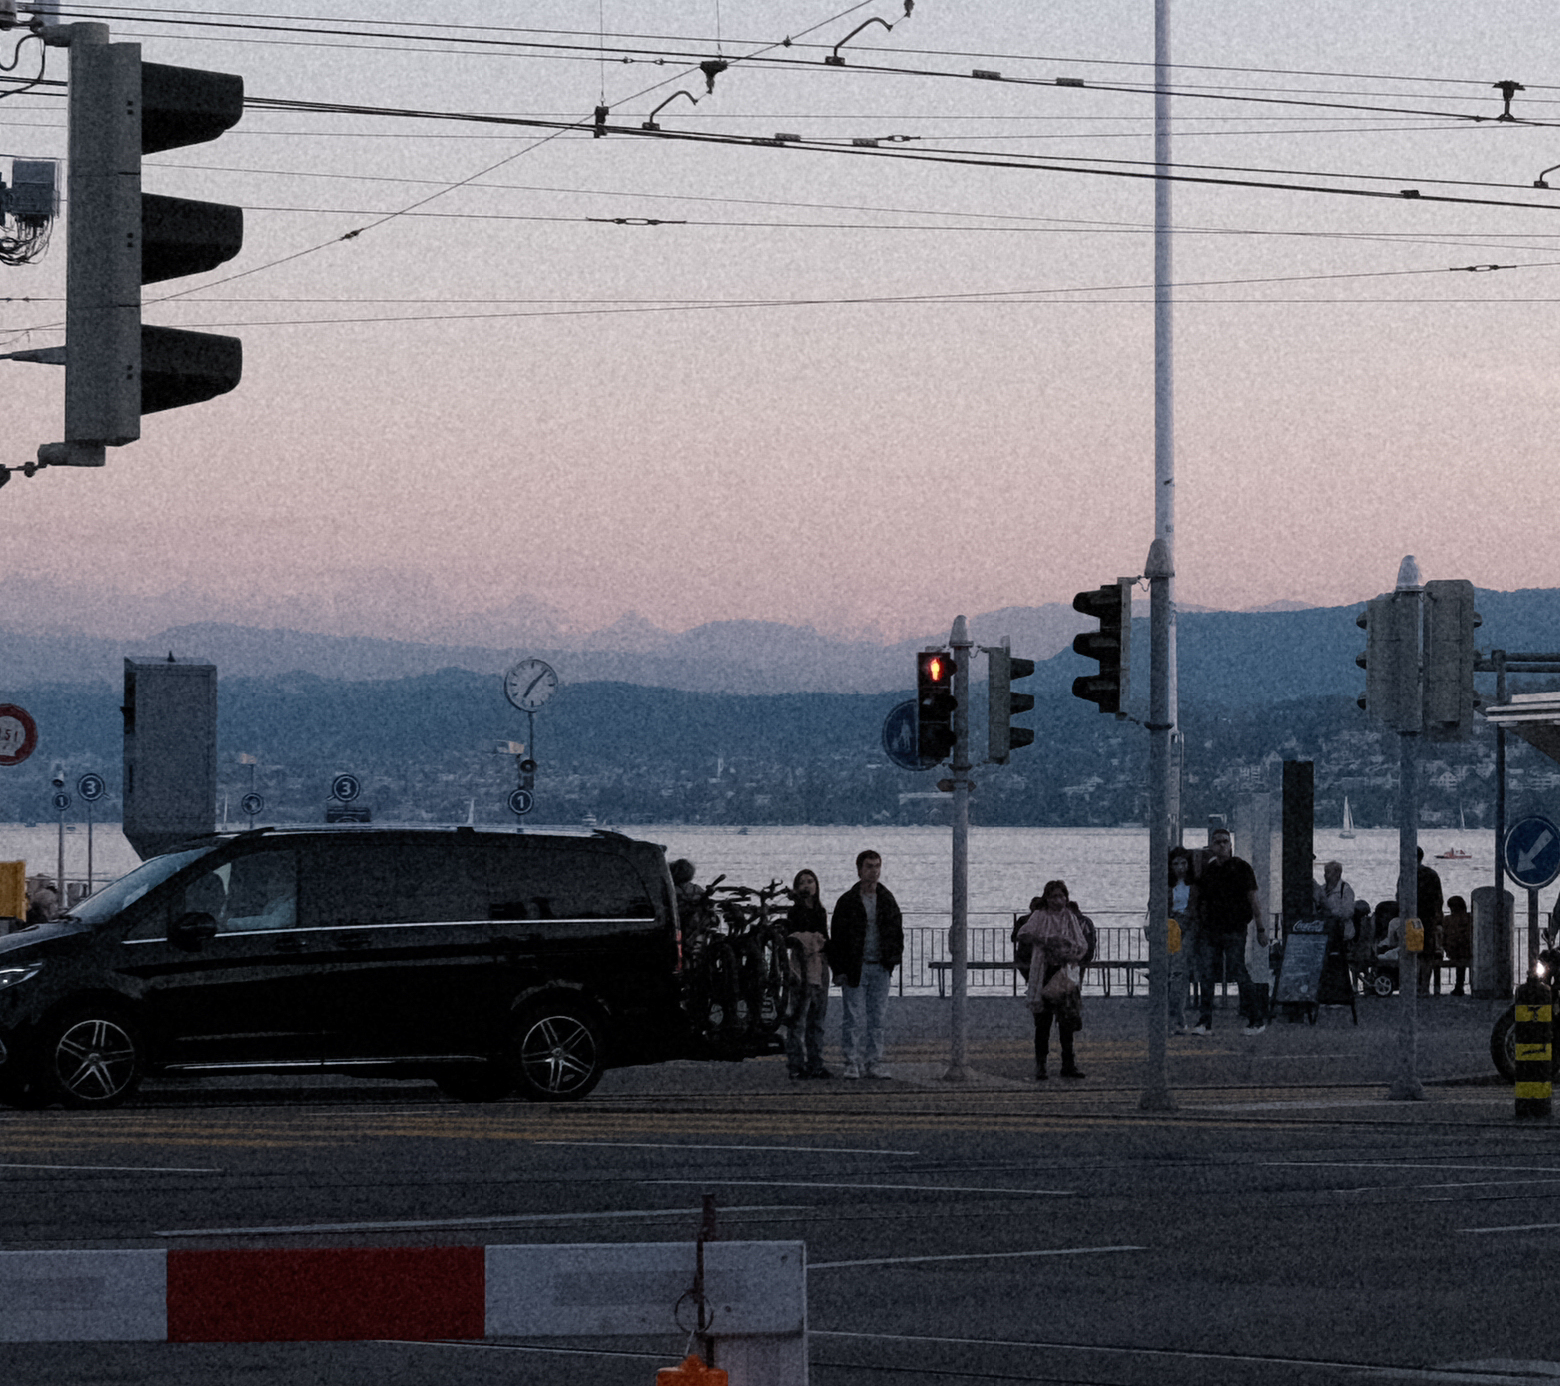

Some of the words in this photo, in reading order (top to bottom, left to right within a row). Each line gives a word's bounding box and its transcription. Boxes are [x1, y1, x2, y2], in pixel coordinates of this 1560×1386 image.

[85, 780, 96, 795] 3
[341, 781, 352, 796] 3
[516, 793, 525, 809] 1
